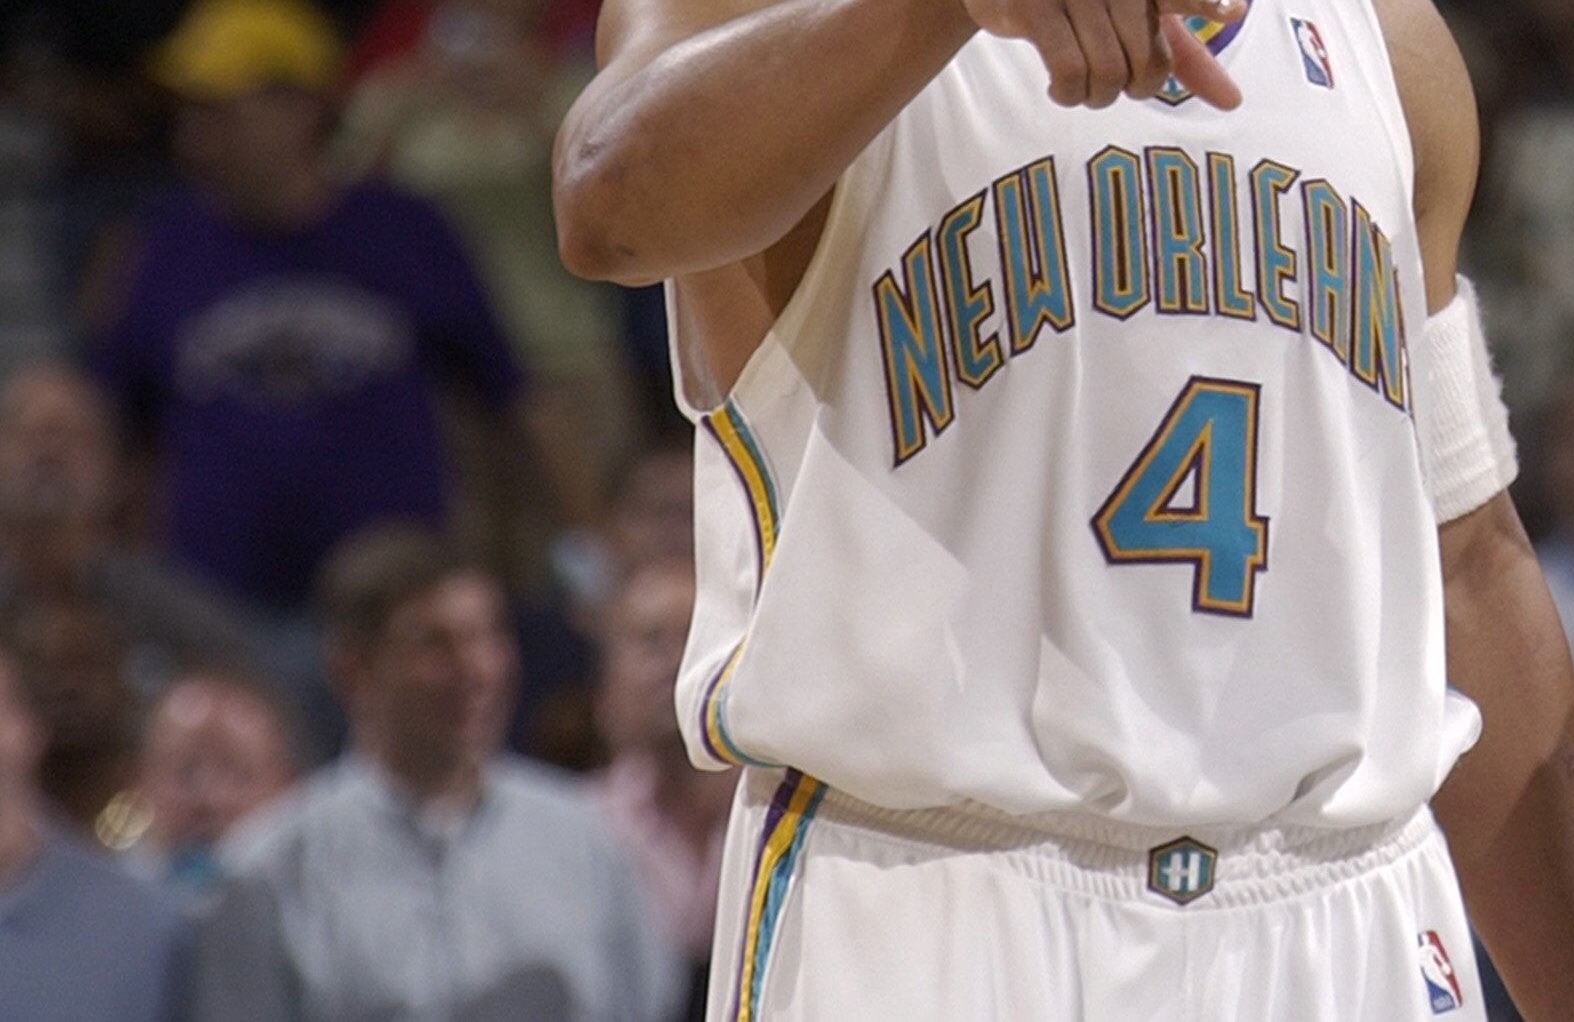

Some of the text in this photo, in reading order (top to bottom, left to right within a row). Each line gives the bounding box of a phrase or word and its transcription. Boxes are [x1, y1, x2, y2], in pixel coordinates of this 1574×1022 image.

[872, 144, 1414, 468] NEW ORLEAN
[1090, 375, 1269, 619] 4
